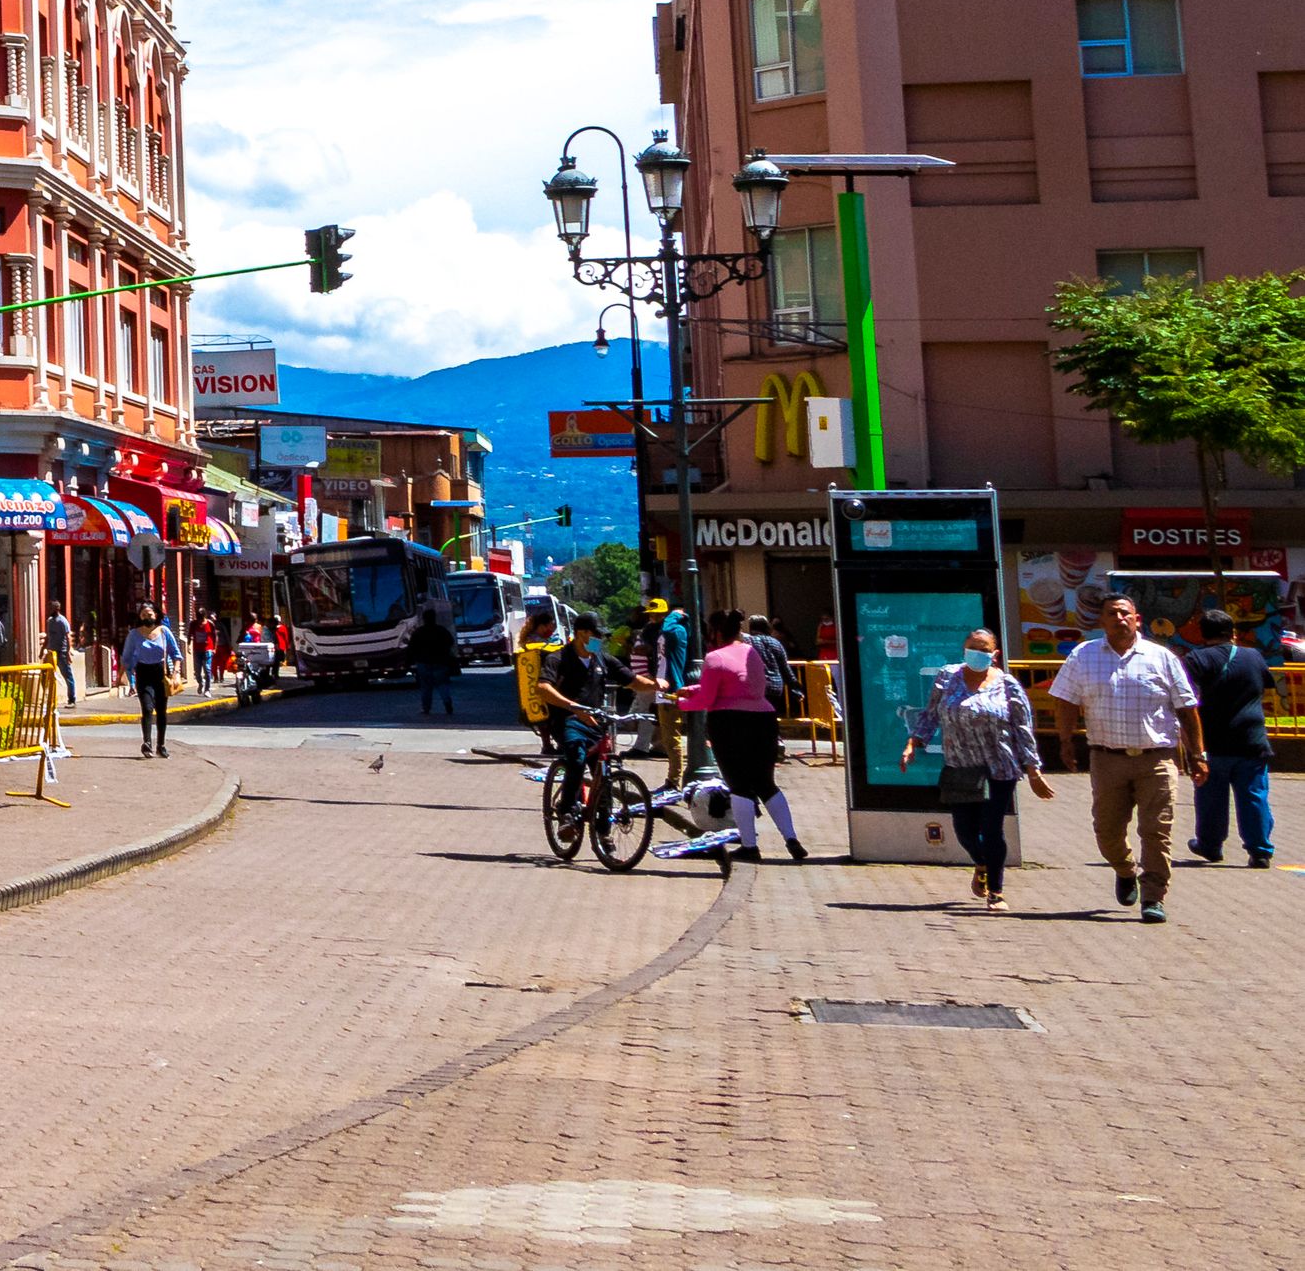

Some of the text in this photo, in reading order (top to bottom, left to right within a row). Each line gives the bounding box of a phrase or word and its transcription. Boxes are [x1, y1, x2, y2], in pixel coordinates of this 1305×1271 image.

[193, 374, 275, 394] VISION
[323, 479, 368, 491] VIDEO
[4, 516, 10, 525] a
[1133, 528, 1242, 545] POSTRES
[229, 560, 268, 569] VISION
